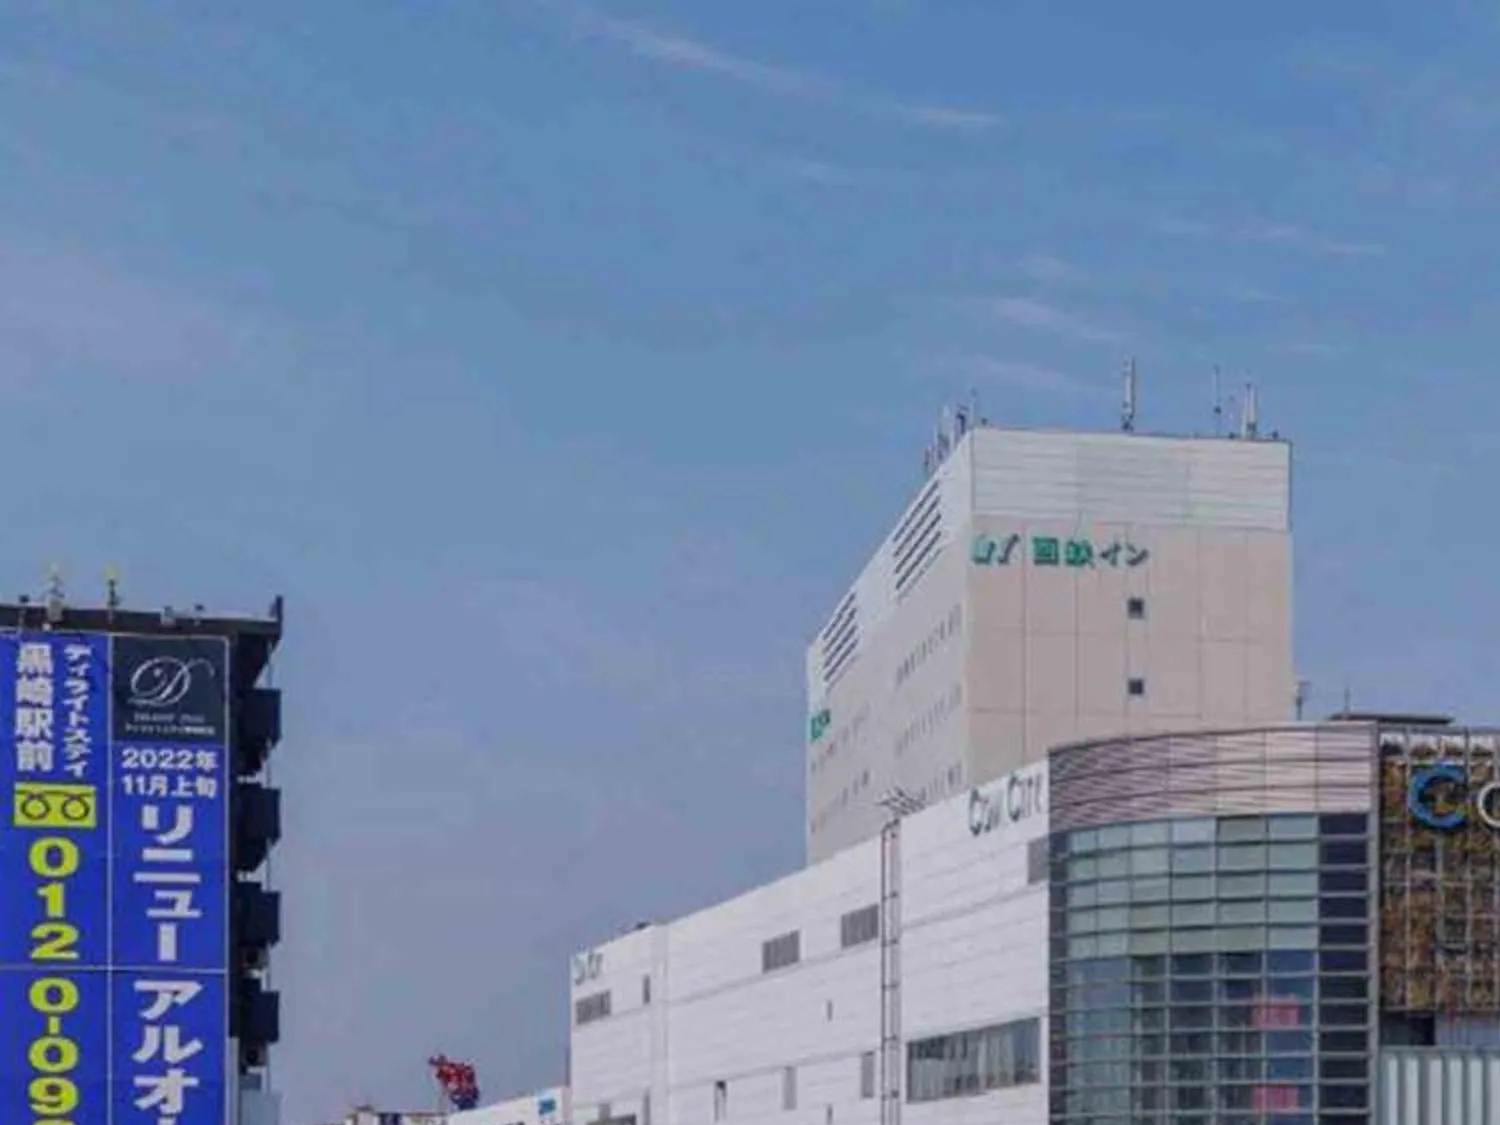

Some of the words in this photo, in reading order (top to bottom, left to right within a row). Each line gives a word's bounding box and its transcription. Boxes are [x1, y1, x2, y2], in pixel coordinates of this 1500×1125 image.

[121, 747, 219, 772] 2022年
[122, 775, 219, 801] 11月上旬
